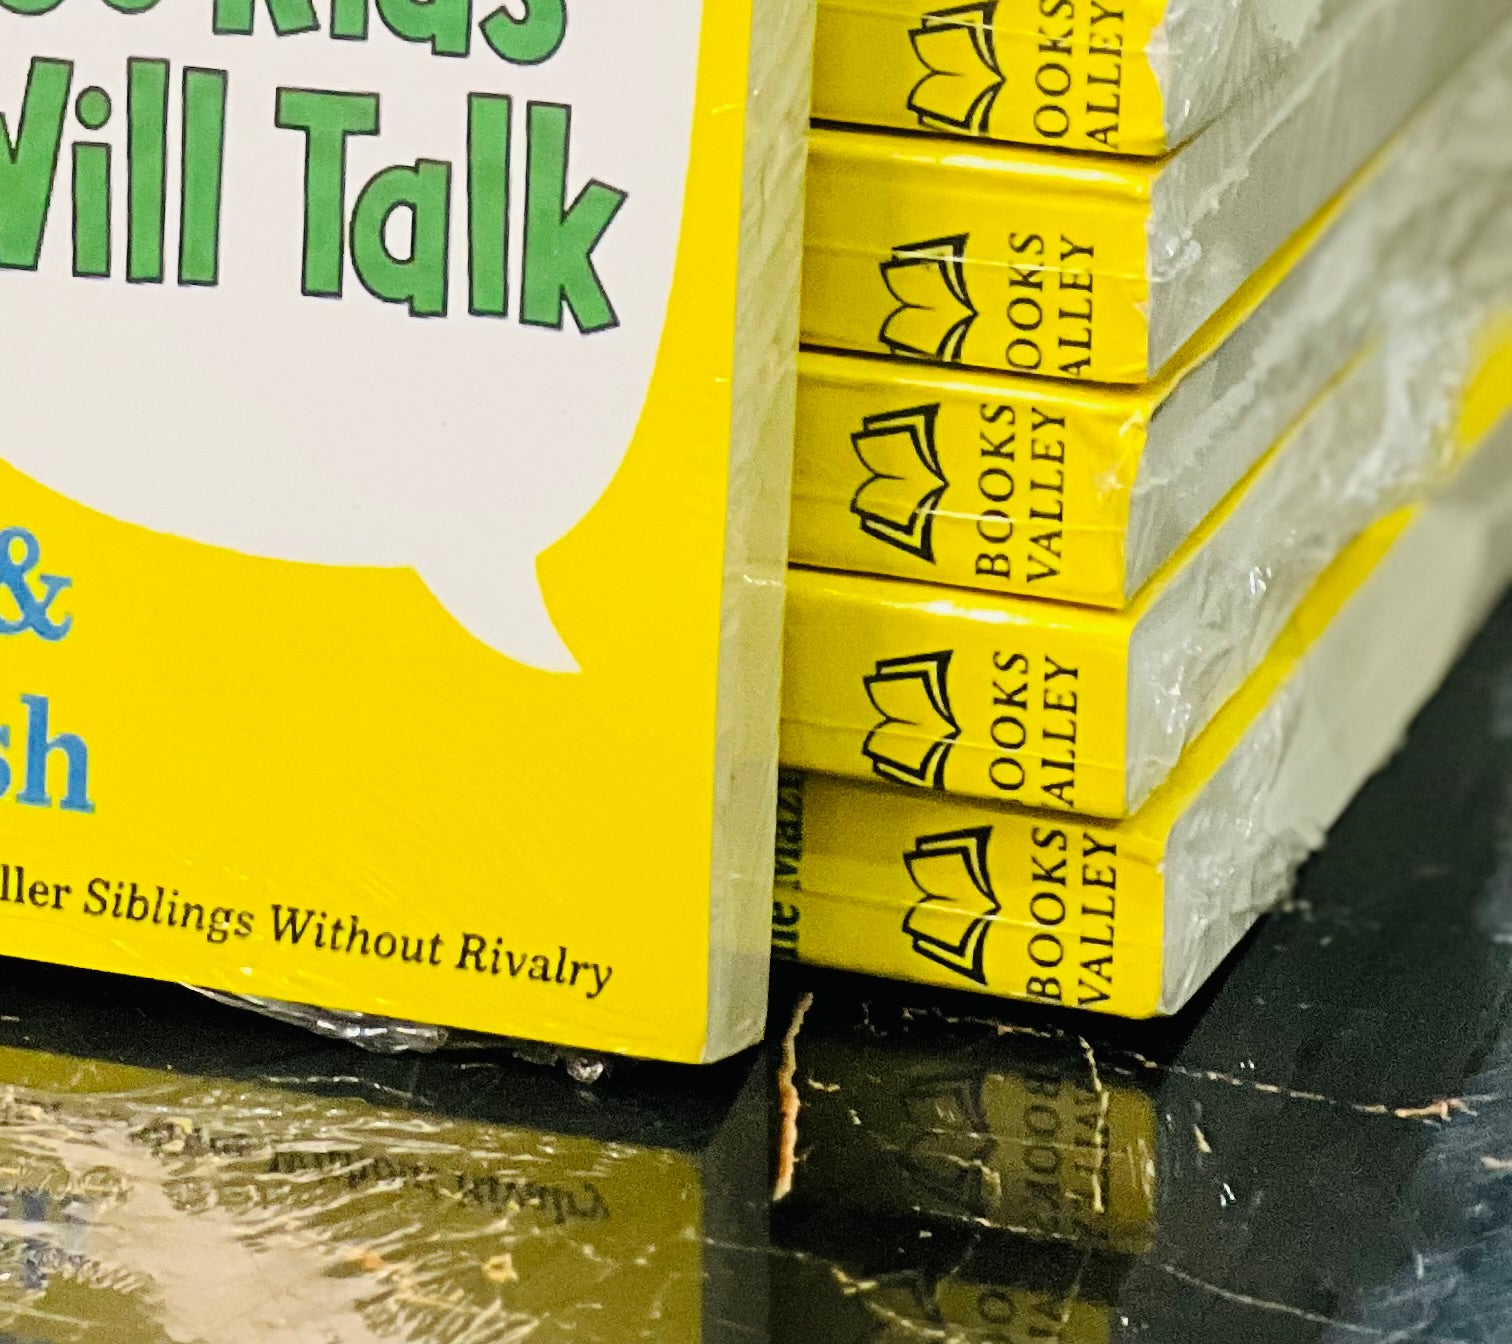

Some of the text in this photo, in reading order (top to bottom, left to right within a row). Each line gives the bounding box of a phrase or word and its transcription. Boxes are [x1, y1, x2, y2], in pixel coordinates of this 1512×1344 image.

[275, 86, 630, 336] Talk
[975, 401, 1017, 581] BOOKS
[1027, 406, 1068, 585] VALLEY
[82, 876, 255, 945] Siblings
[269, 903, 445, 970] Without
[454, 932, 615, 998] Rivalry
[1025, 825, 1069, 1003] BOOKS
[1078, 833, 1119, 1009] VALLEY
